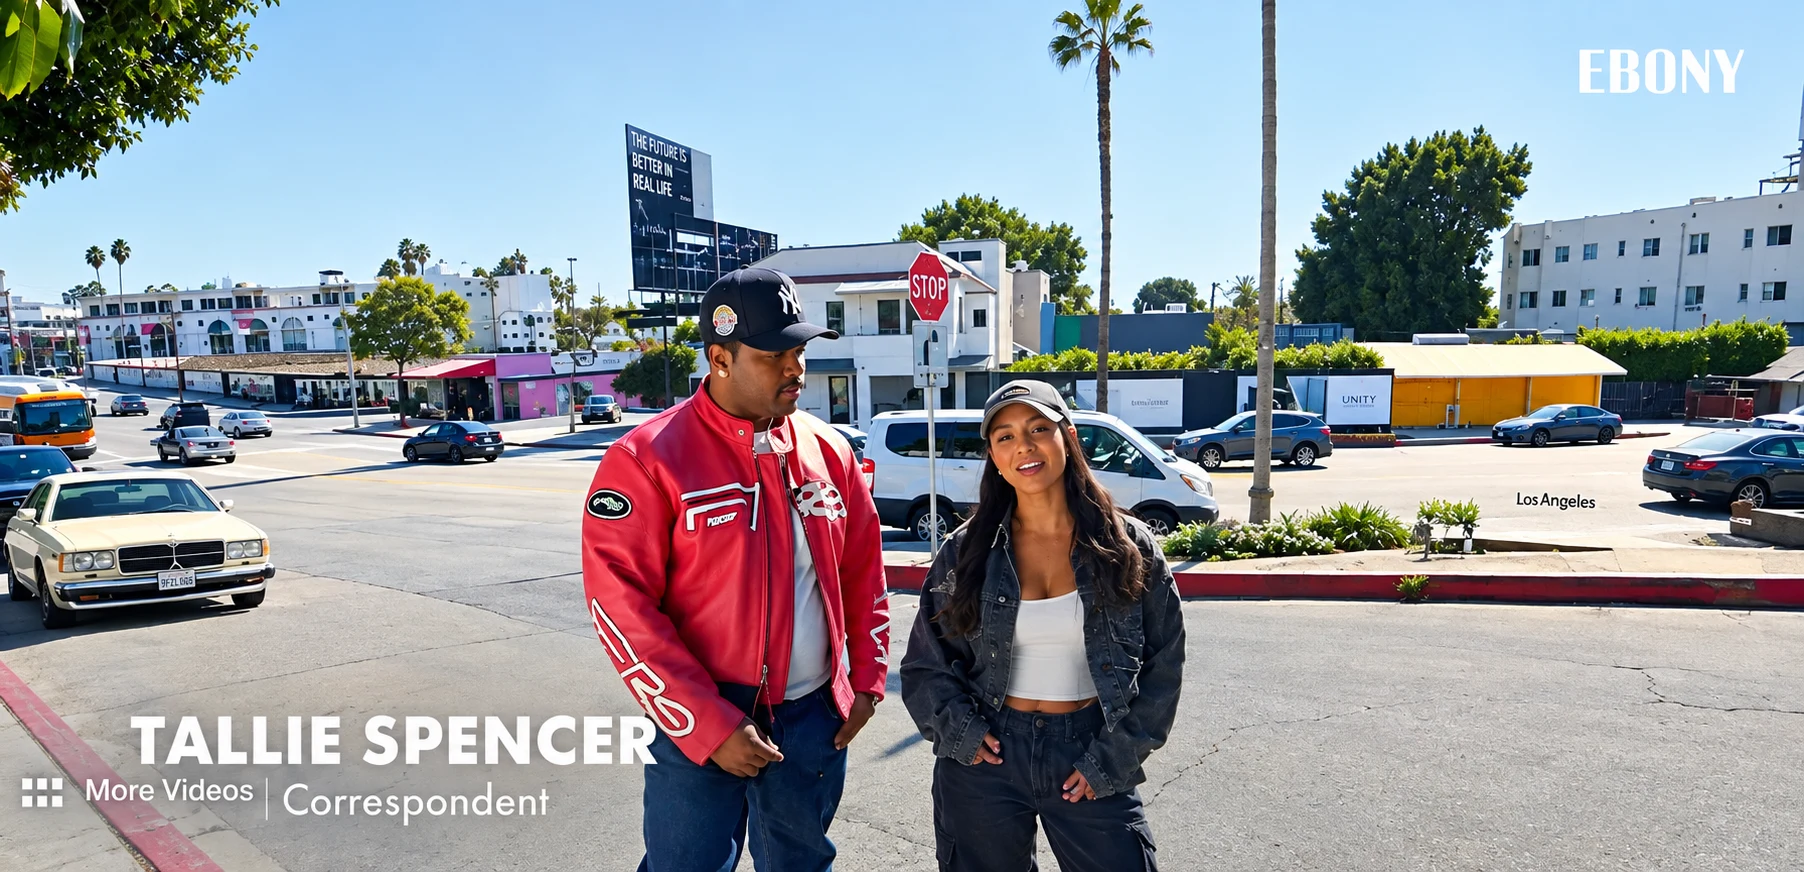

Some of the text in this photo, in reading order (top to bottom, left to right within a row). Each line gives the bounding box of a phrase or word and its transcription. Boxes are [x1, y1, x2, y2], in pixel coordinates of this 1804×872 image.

[631, 131, 687, 163] THE FUTURE IS
[632, 152, 673, 178] BETTER IN
[633, 173, 673, 197] REAL LIFE
[912, 274, 947, 300] STOP
[1342, 395, 1377, 404] UNITY
